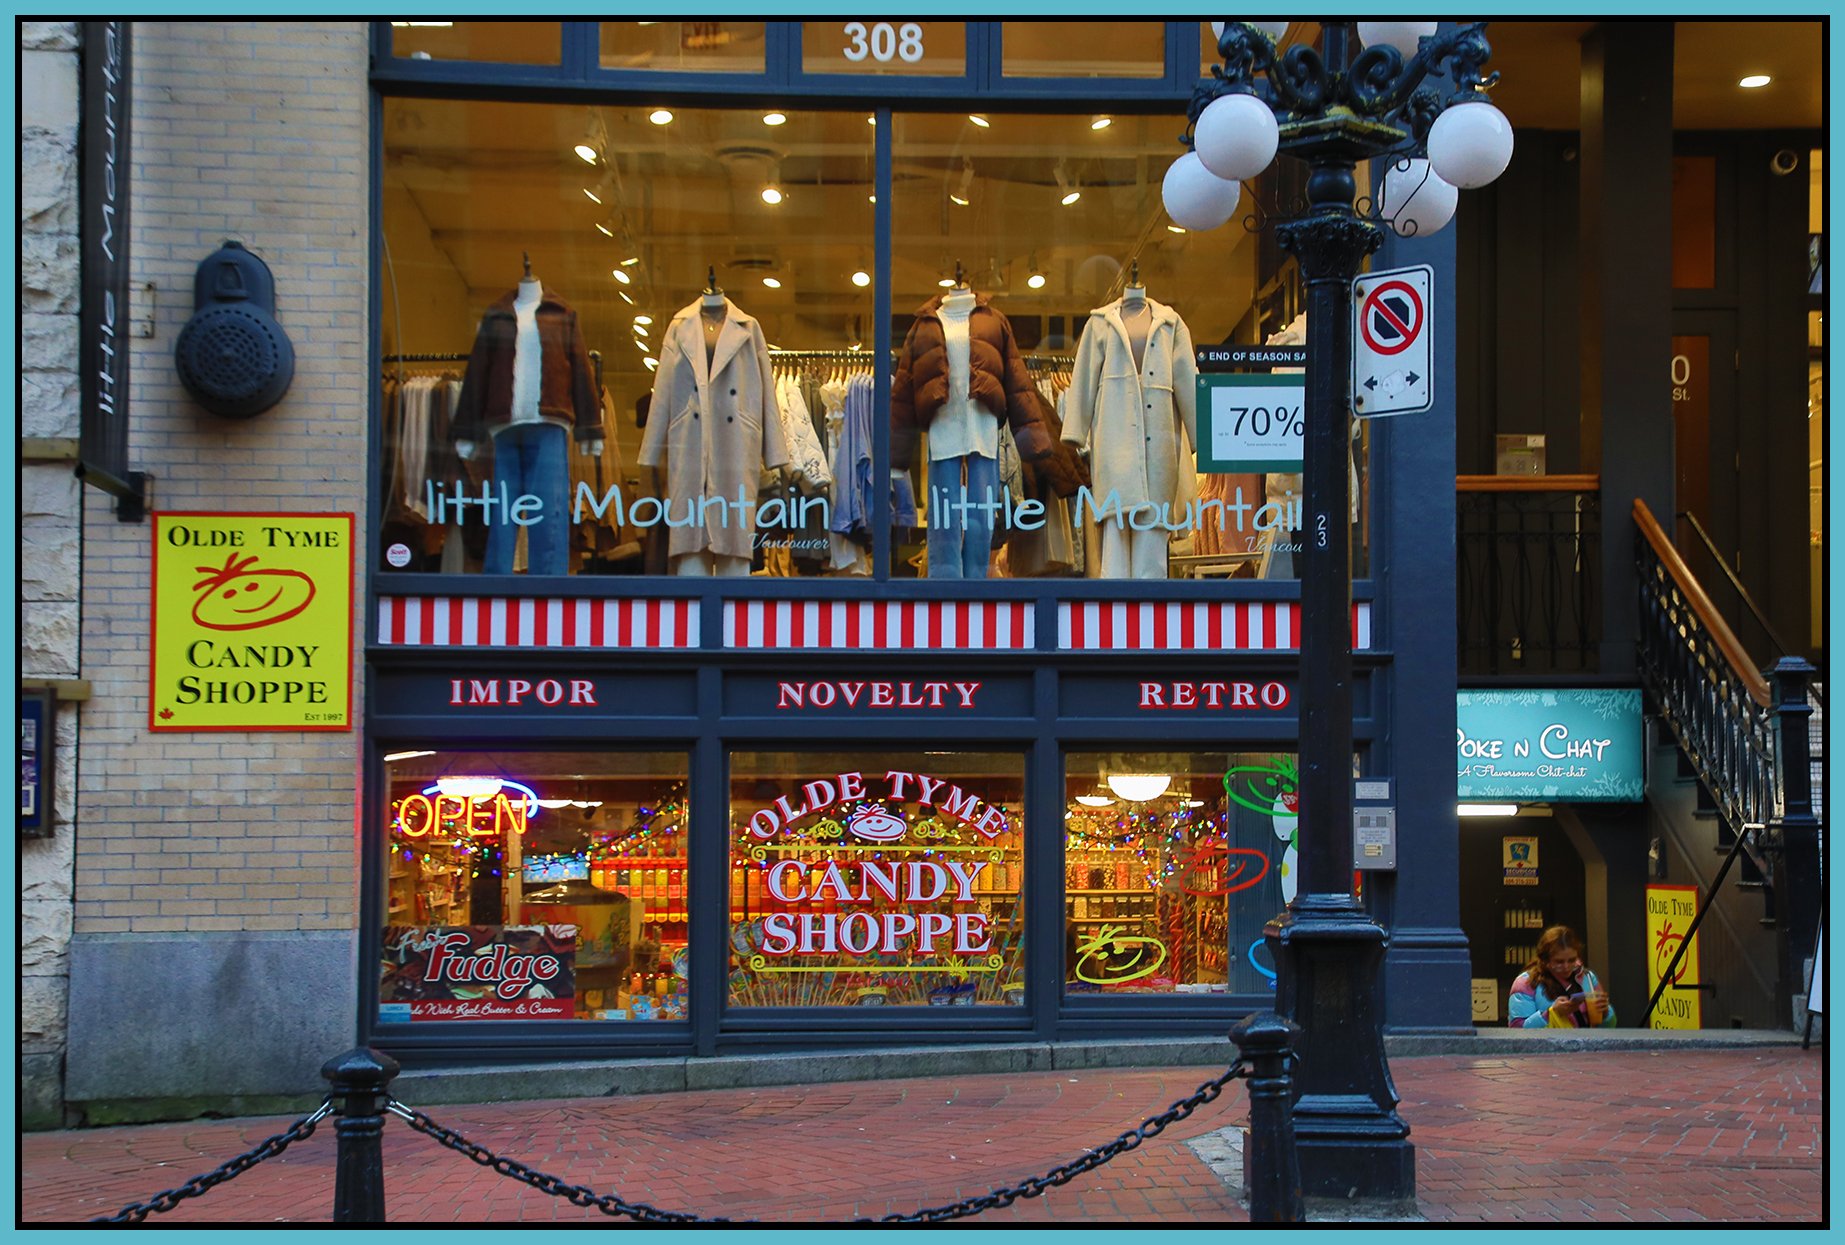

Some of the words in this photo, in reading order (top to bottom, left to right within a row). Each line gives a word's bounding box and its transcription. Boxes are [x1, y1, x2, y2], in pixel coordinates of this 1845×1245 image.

[843, 22, 924, 62] 308
[1209, 352, 1230, 361] END
[1232, 352, 1247, 361] OF
[1249, 352, 1291, 361] SEASON
[1673, 387, 1690, 401] St.
[1230, 406, 1305, 437] 70%
[426, 479, 544, 526] little
[573, 480, 829, 529] Mountain
[931, 485, 1046, 531] little
[168, 525, 245, 547] OLDE
[262, 527, 340, 548] TYME
[748, 532, 830, 550] Vancouver
[186, 639, 320, 669] CANDY
[176, 676, 329, 704] SHOPPE
[449, 679, 599, 706] IMPOR
[777, 681, 980, 709] NOVELTY
[1138, 680, 1291, 710] RETRO
[323, 712, 343, 721] 1997
[1458, 765, 1471, 777] A
[1473, 765, 1535, 777] Flavorsome
[1537, 765, 1588, 777] Chit-chat
[399, 793, 528, 838] OPEN
[750, 771, 867, 840] OLDE
[884, 770, 1008, 840] TYME
[767, 859, 988, 902] CANDY
[1648, 897, 1669, 914] OLDE
[1671, 899, 1694, 916] TYME
[762, 911, 993, 956] SHOPPE
[424, 932, 560, 1000] Fudge
[425, 1003, 454, 1015] With
[481, 1003, 513, 1015] Butter
[529, 1002, 562, 1015] Cream
